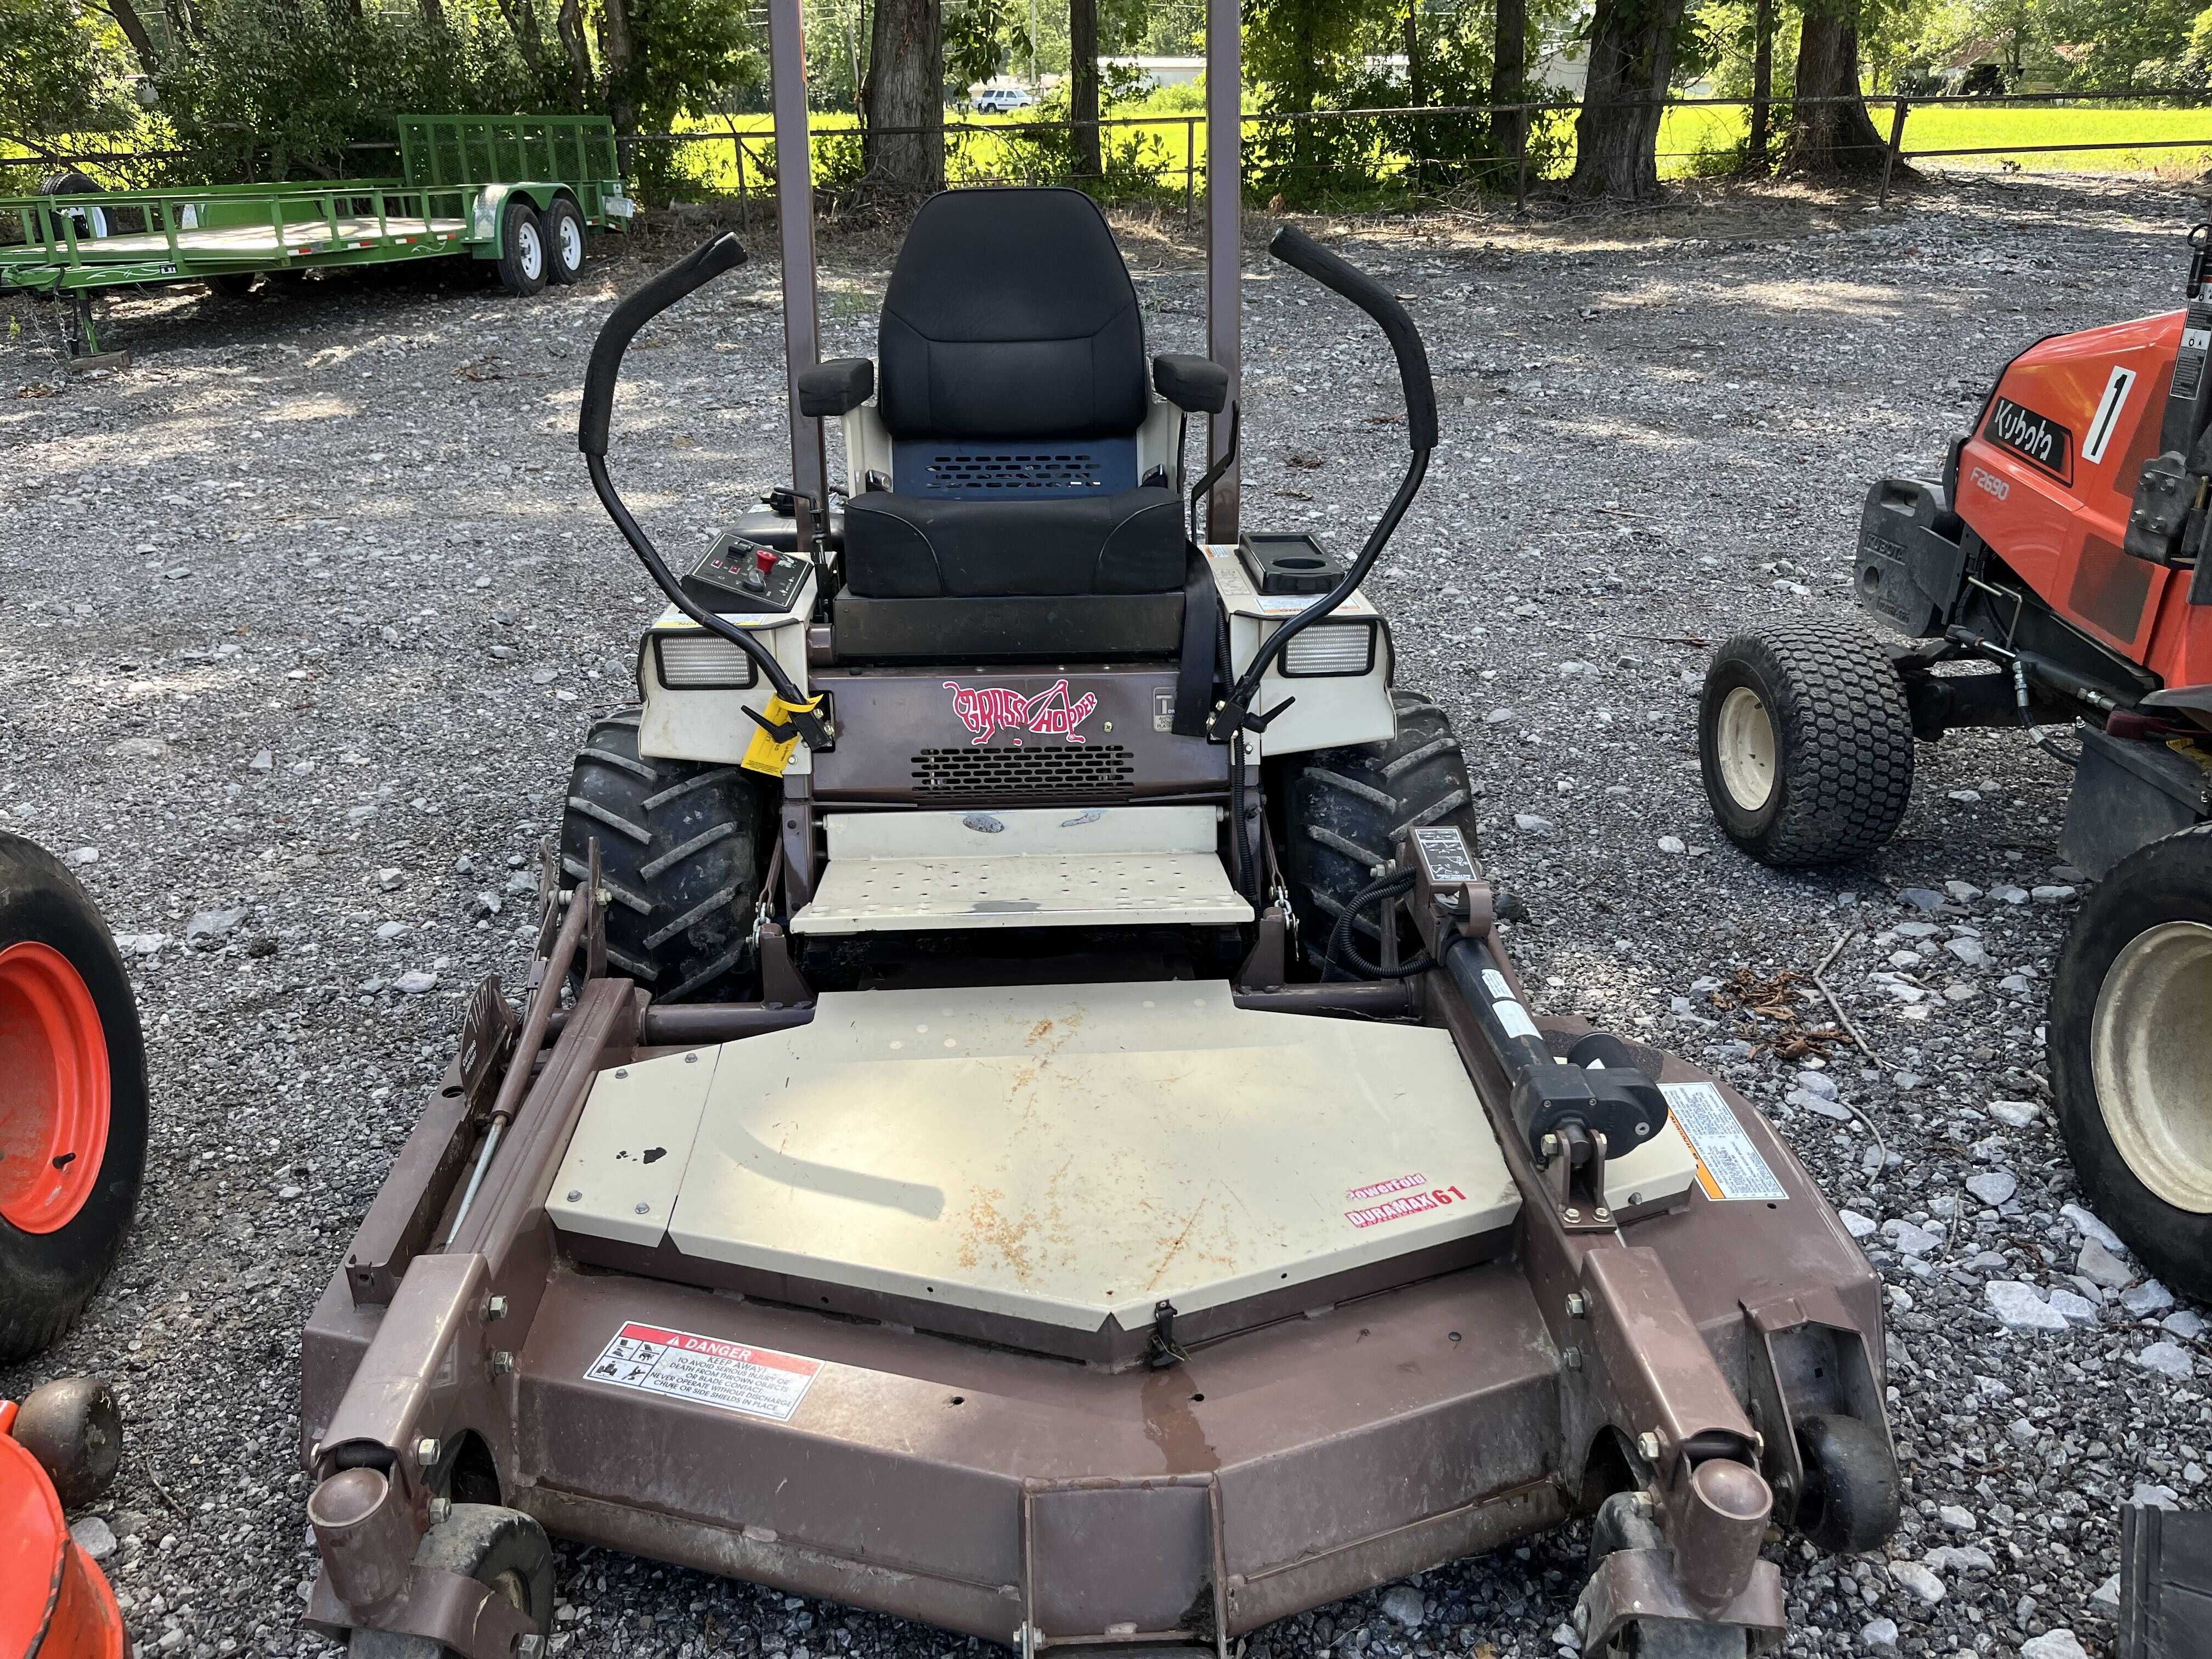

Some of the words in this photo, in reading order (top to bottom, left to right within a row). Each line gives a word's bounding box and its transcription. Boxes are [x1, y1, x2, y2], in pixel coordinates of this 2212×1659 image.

[1994, 399, 2052, 460] Kubota
[1970, 467, 2011, 500] F2690
[1432, 1186, 1466, 1205] 61
[684, 1339, 752, 1361] DANGER
[688, 1359, 715, 1369] AVOID
[714, 1365, 748, 1376] SERIOUS
[747, 1372, 776, 1382] INJURY
[707, 1356, 733, 1367] KEEP
[732, 1361, 768, 1374] AWAY!
[668, 1362, 696, 1372] DEATH
[694, 1367, 720, 1377] FROM
[719, 1373, 755, 1385] THROWN
[753, 1380, 790, 1392] OBJECTS
[697, 1375, 724, 1385] BLADE
[649, 1372, 676, 1381] NEVER
[674, 1377, 710, 1389] OPERATE
[709, 1385, 746, 1397] WITHOUT
[744, 1392, 793, 1407] DISCHARGE
[691, 1387, 710, 1396] SIDE
[709, 1391, 742, 1403] SHIELDS
